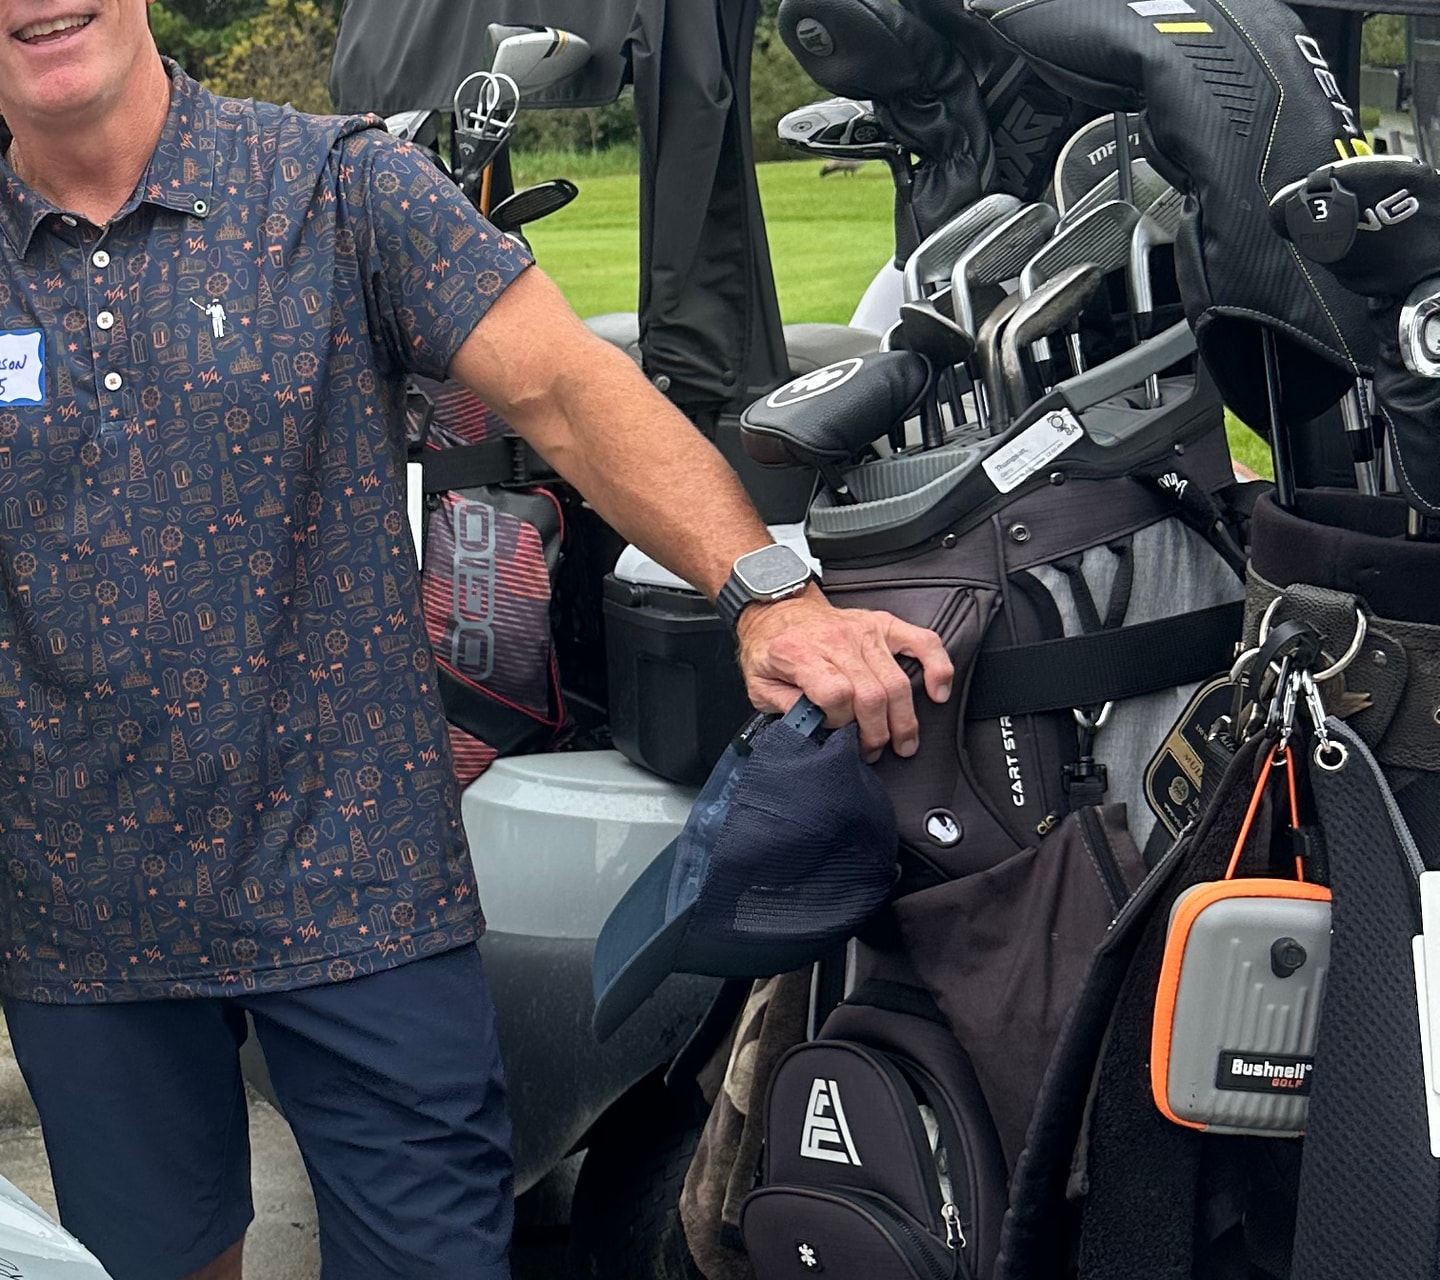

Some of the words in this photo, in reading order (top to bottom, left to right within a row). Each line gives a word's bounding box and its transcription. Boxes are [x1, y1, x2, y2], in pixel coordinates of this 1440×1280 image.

[1313, 199, 1329, 221] 3
[1005, 754, 1026, 808] CART
[1231, 1058, 1306, 1080] Bushnell
[1271, 1077, 1305, 1089] GOLF
